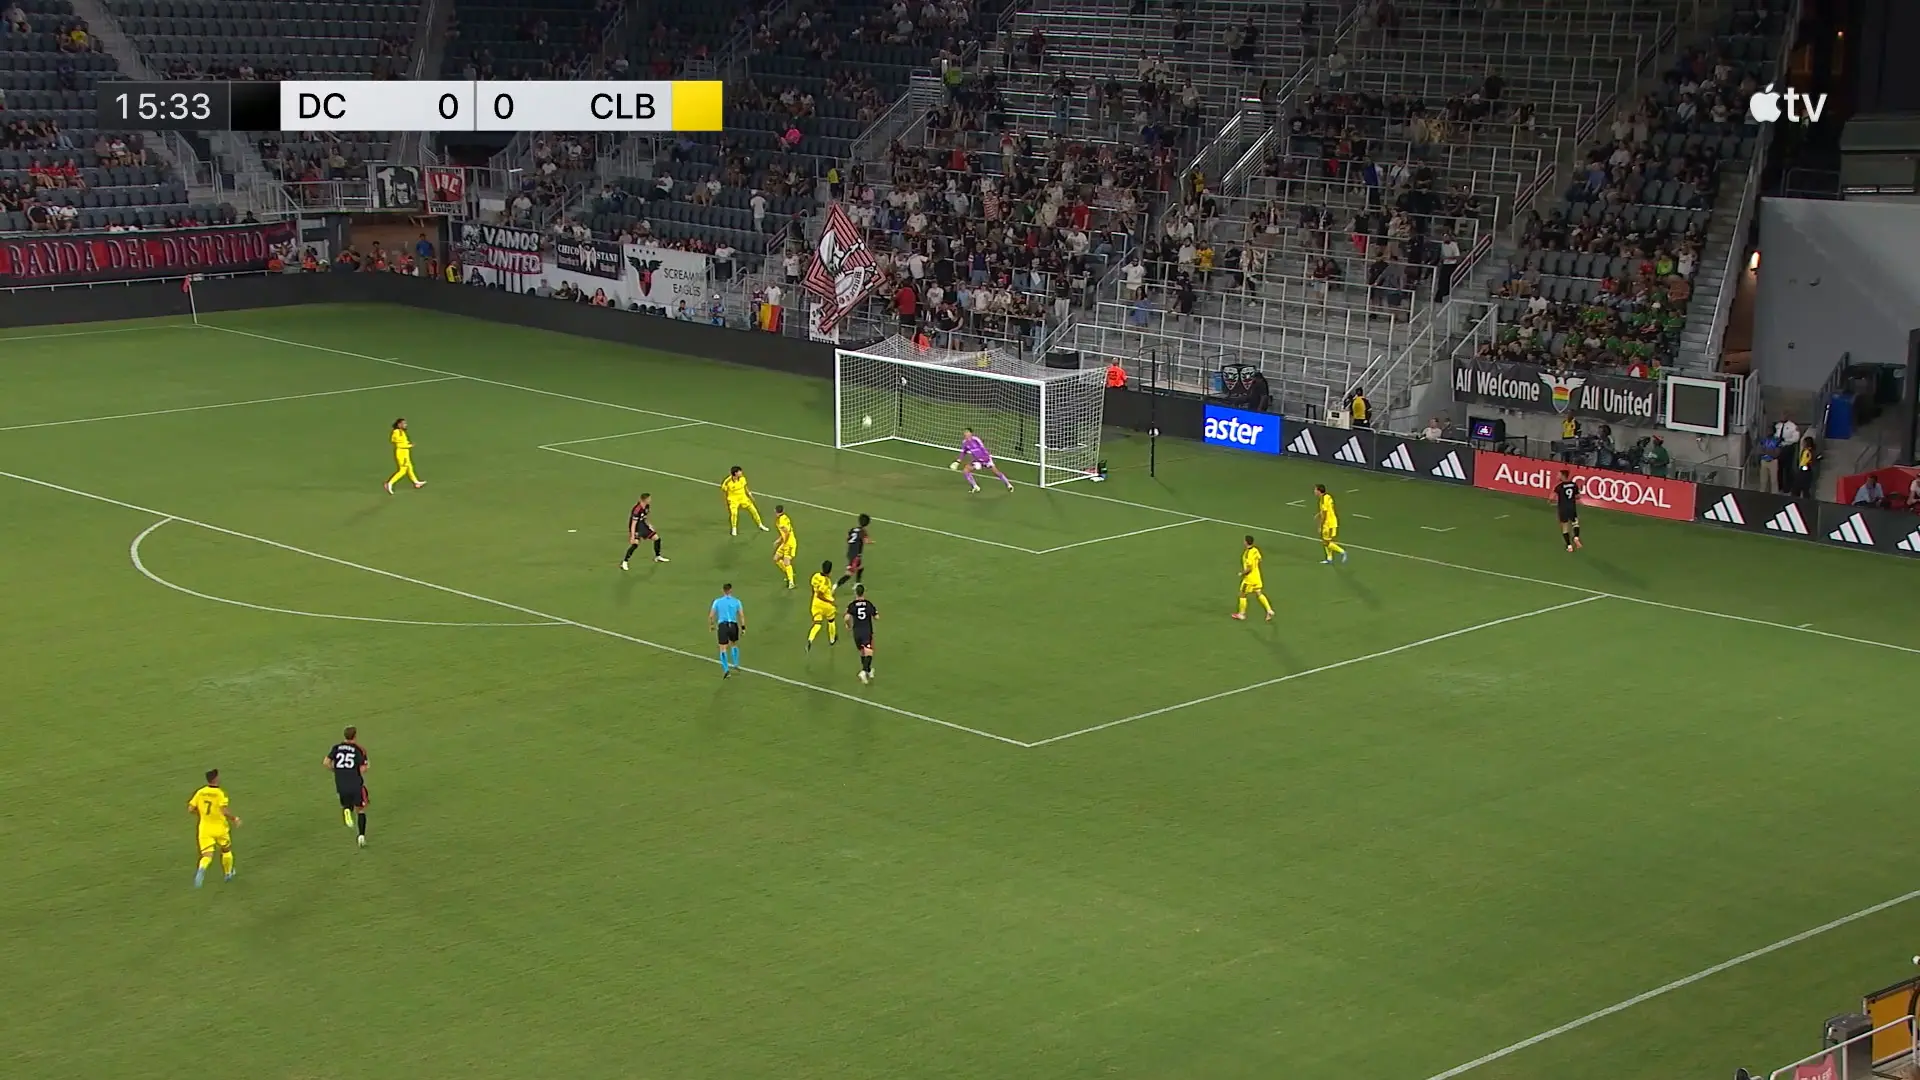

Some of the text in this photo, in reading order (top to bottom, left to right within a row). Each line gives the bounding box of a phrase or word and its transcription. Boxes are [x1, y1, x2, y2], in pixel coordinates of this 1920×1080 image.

[482, 226, 539, 252] VAMOS
[557, 244, 580, 256] CHICO
[9, 230, 266, 278] BANDA DEL DISTRITO
[487, 248, 541, 273] UNITED
[1456, 367, 1653, 417] All Welcome All United
[1204, 417, 1263, 446] aster
[1494, 463, 1551, 490] Audi
[1564, 488, 1574, 500] 9
[856, 607, 867, 620] 5
[336, 752, 356, 769] 25
[204, 800, 213, 816] 7
